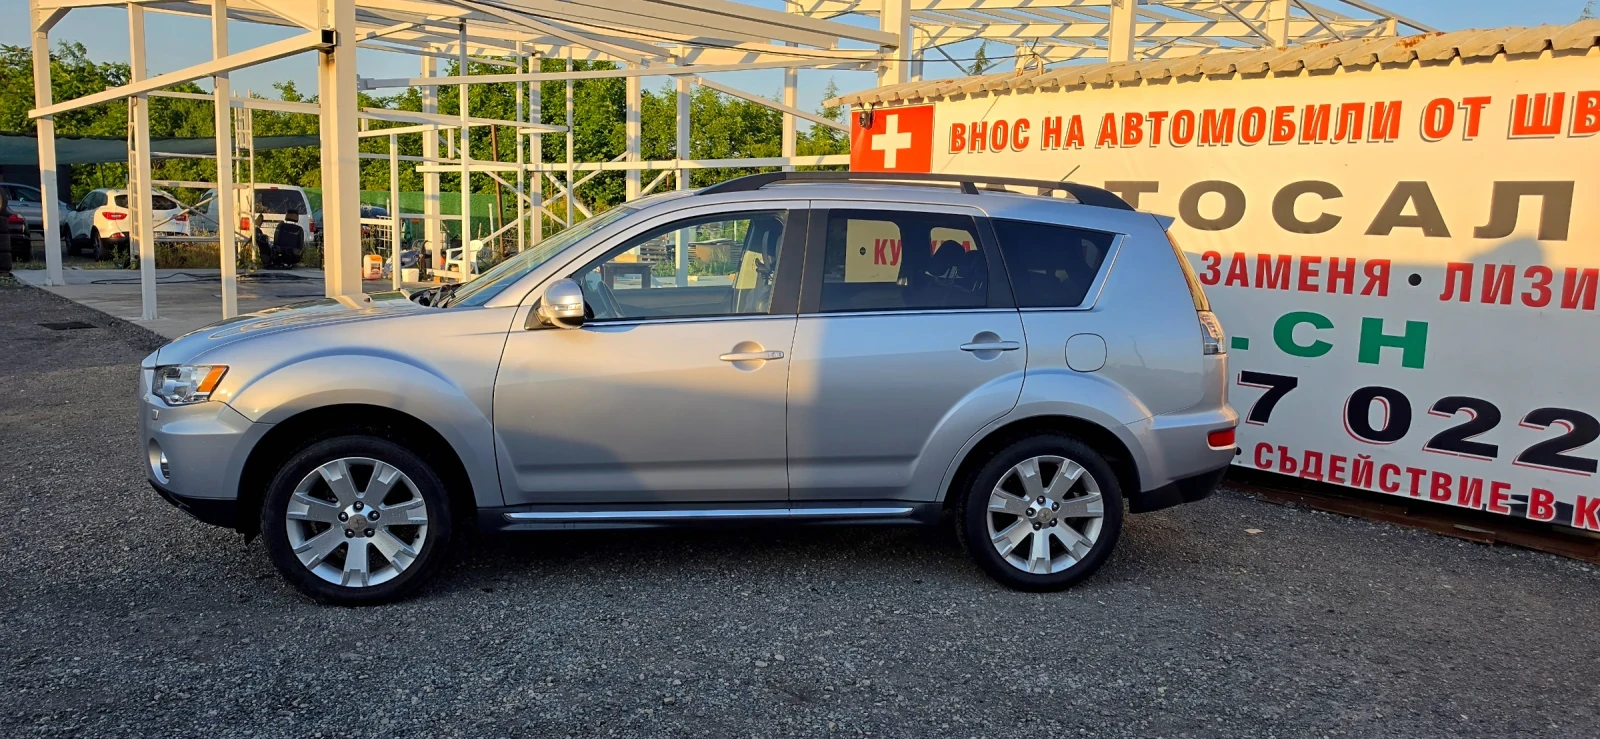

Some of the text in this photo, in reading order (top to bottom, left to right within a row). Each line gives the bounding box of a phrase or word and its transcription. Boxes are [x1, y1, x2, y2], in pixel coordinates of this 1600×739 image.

[949, 90, 1600, 154] ВНОС НА АВТОМОБИЛИ ОТ ШВ
[985, 180, 1575, 241] ТОСАЛ
[1200, 250, 1600, 311] ЗАМЕНЯ ЛИЗИ
[1342, 385, 1600, 477] 022
[1253, 441, 1513, 516] СЪДЕЙСТВИЕ
[1526, 487, 1556, 522] В
